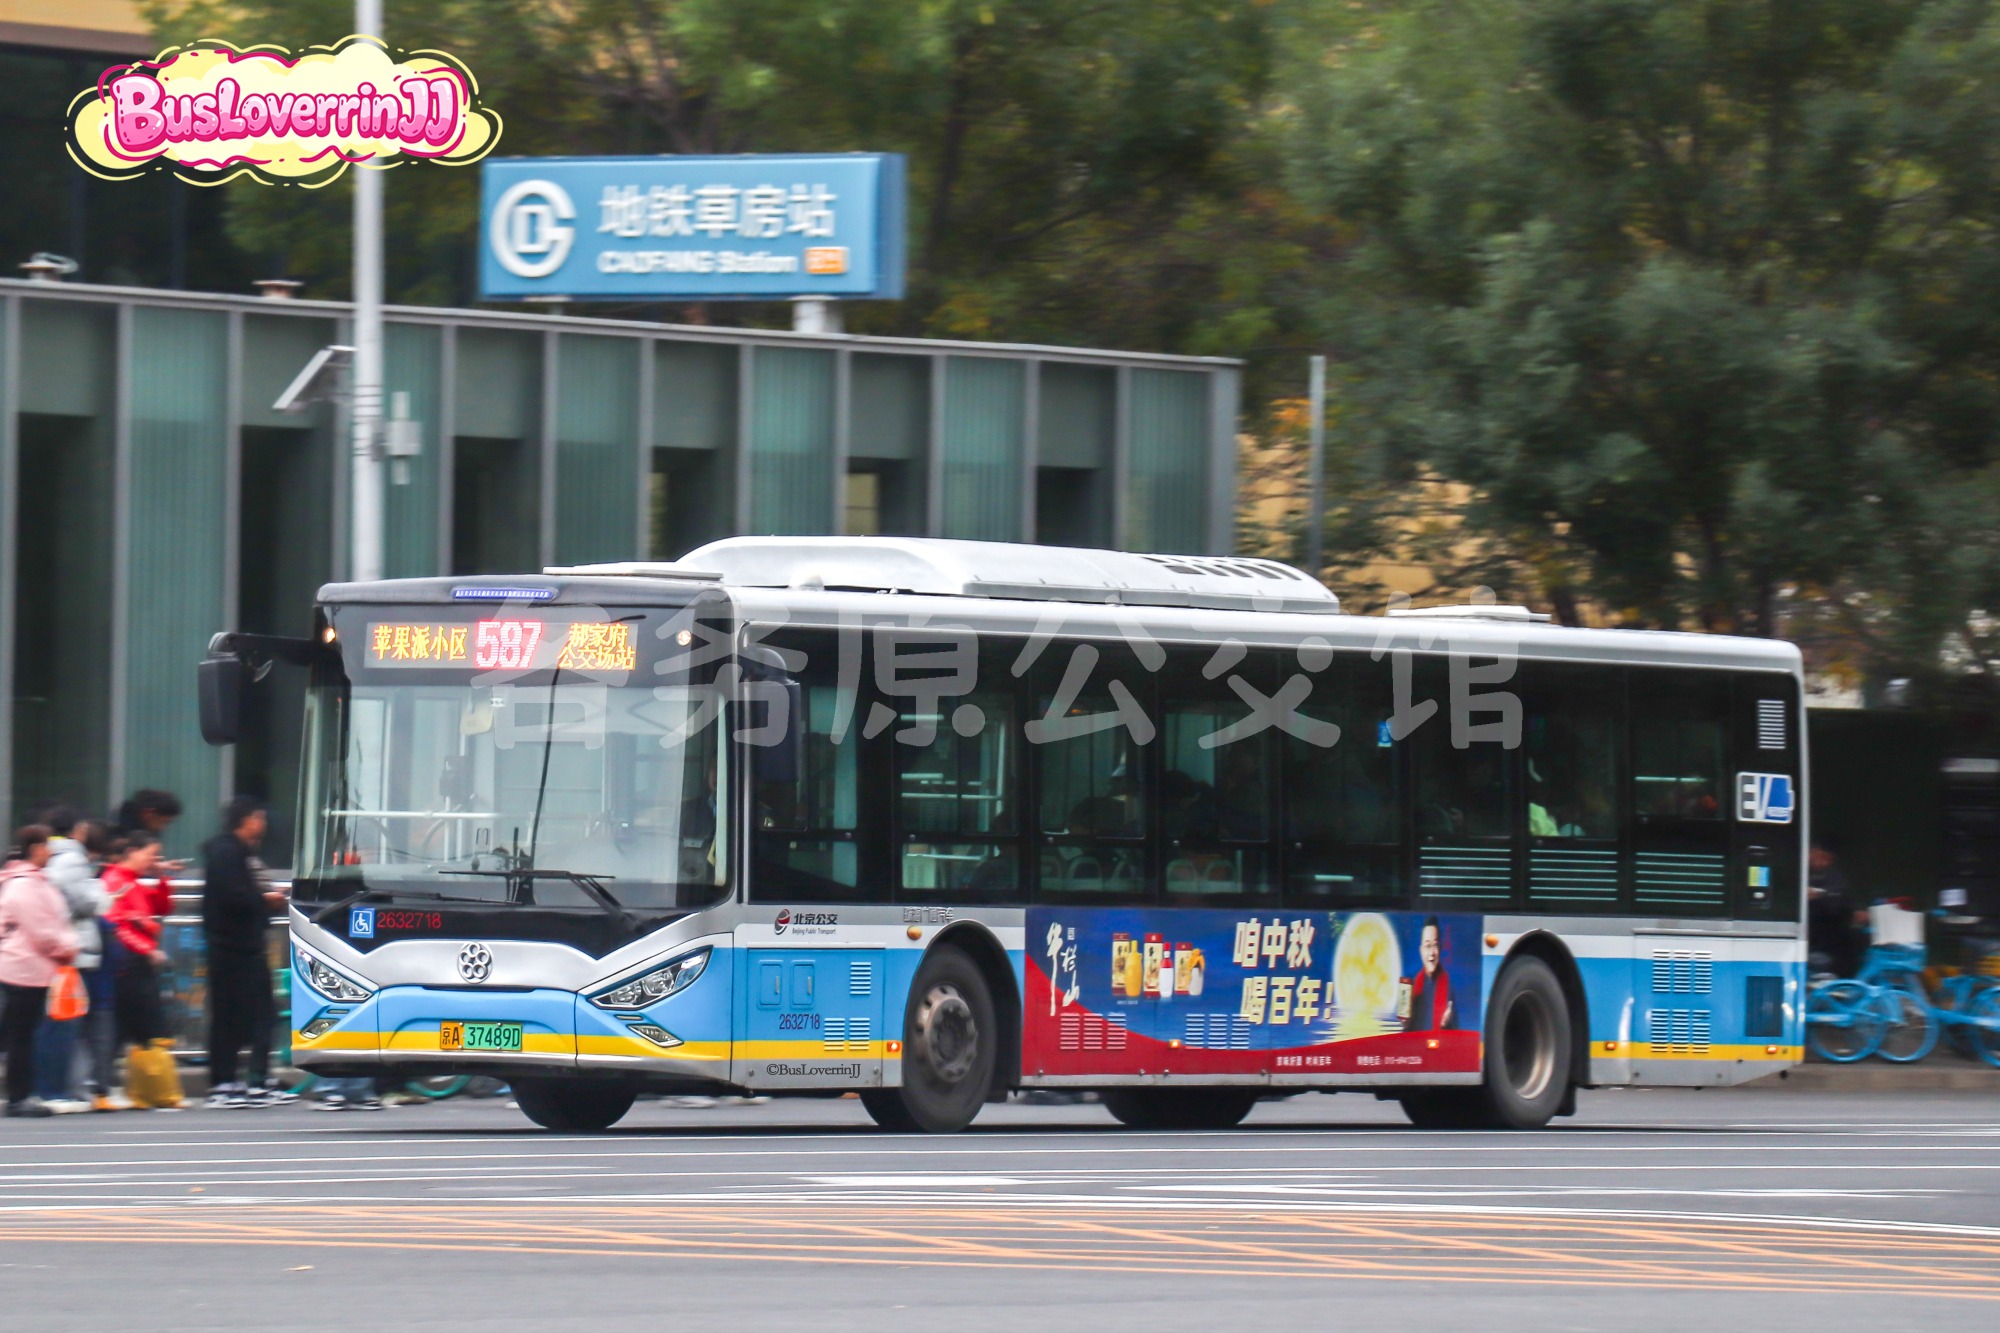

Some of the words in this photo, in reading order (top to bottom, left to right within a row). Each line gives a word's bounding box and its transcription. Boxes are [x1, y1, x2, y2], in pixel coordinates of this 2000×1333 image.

[597, 184, 838, 238] 地铁草房站
[373, 624, 469, 661] 苹果派小区
[475, 620, 542, 668] 587
[557, 646, 636, 671] 公交场站
[376, 911, 442, 930] 2632718
[792, 913, 839, 925] 北京公交
[1232, 917, 1317, 969] 咱中秋
[779, 1013, 821, 1030] 2632718
[442, 1027, 460, 1045] 京A
[467, 1026, 521, 1047] 37489D
